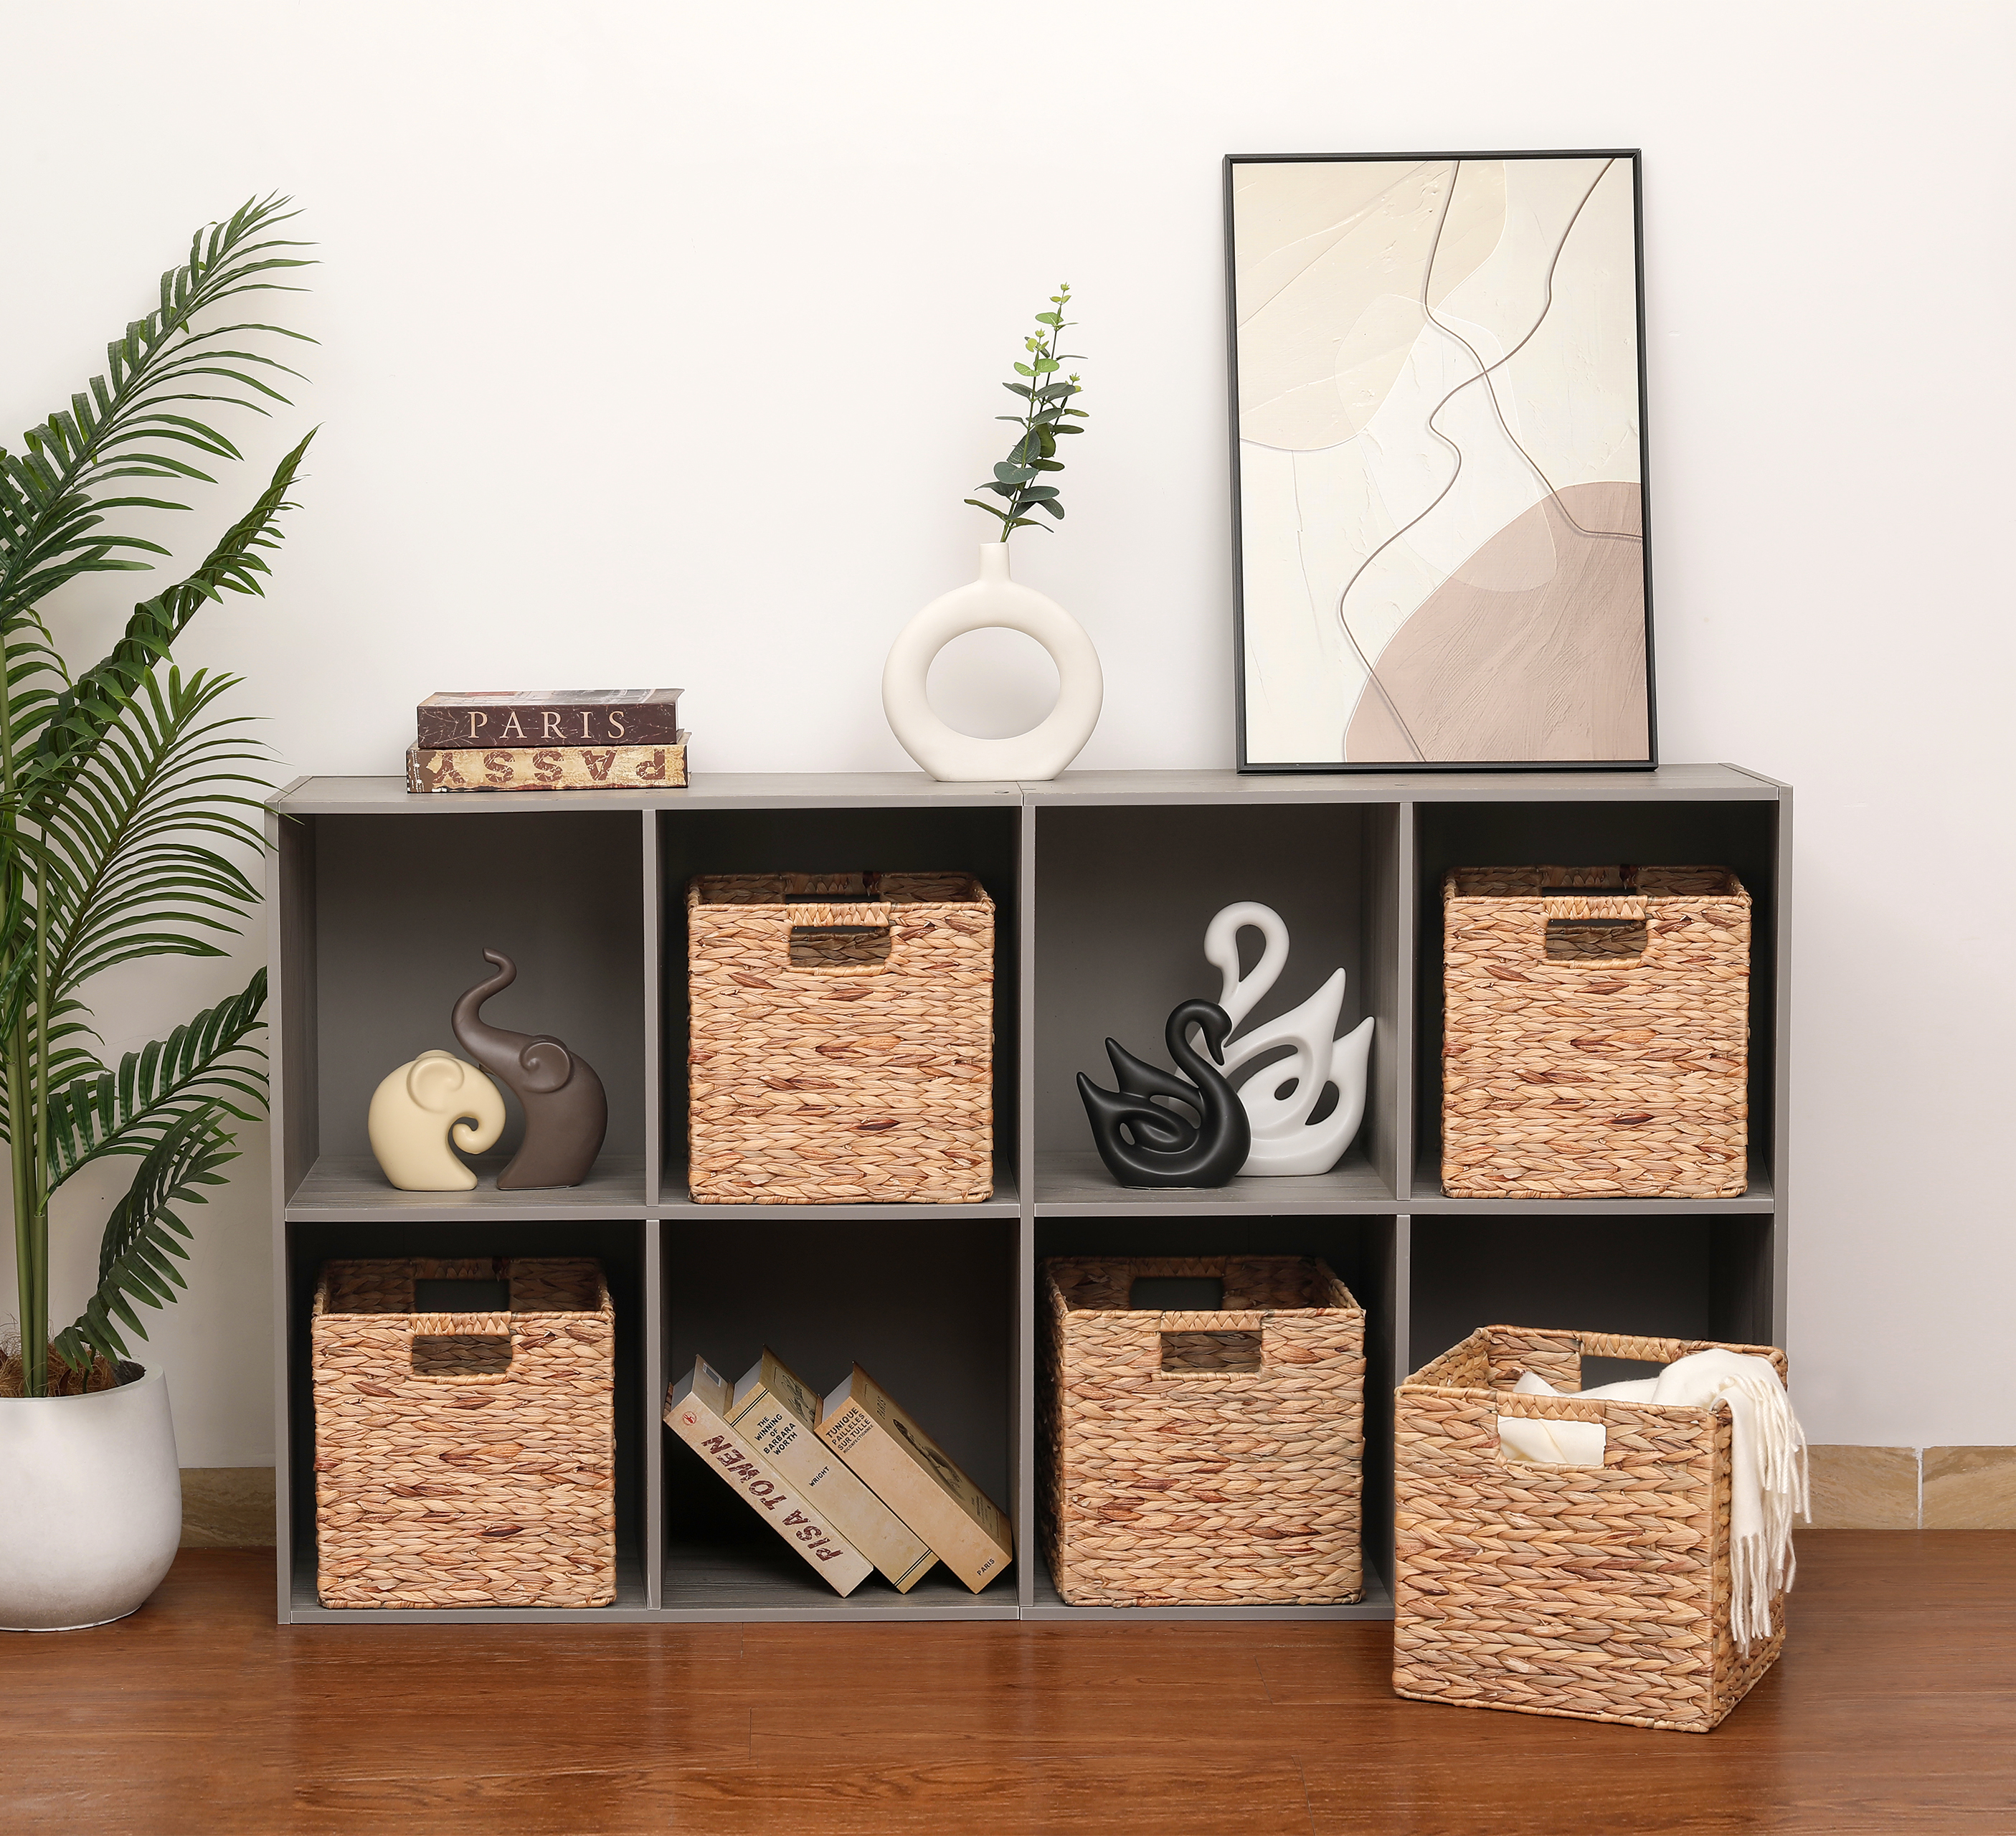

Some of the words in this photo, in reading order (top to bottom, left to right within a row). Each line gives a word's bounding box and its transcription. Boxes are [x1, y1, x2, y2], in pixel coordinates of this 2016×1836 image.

[468, 711, 625, 739] PARIS
[432, 749, 666, 784] PASSY
[754, 1414, 783, 1442] WINNING
[757, 1416, 770, 1428] THE
[770, 1428, 779, 1437] OF
[825, 1406, 859, 1439] TUNIQUE
[832, 1413, 865, 1445] PAILLELES
[838, 1437, 852, 1451] SUR
[850, 1418, 871, 1438] TULLE
[763, 1422, 796, 1454] BARBARA
[773, 1432, 798, 1456] WORTH
[808, 1465, 830, 1487] WRIGHT
[782, 1508, 844, 1562] PISA
[976, 1558, 995, 1576] PARIS
